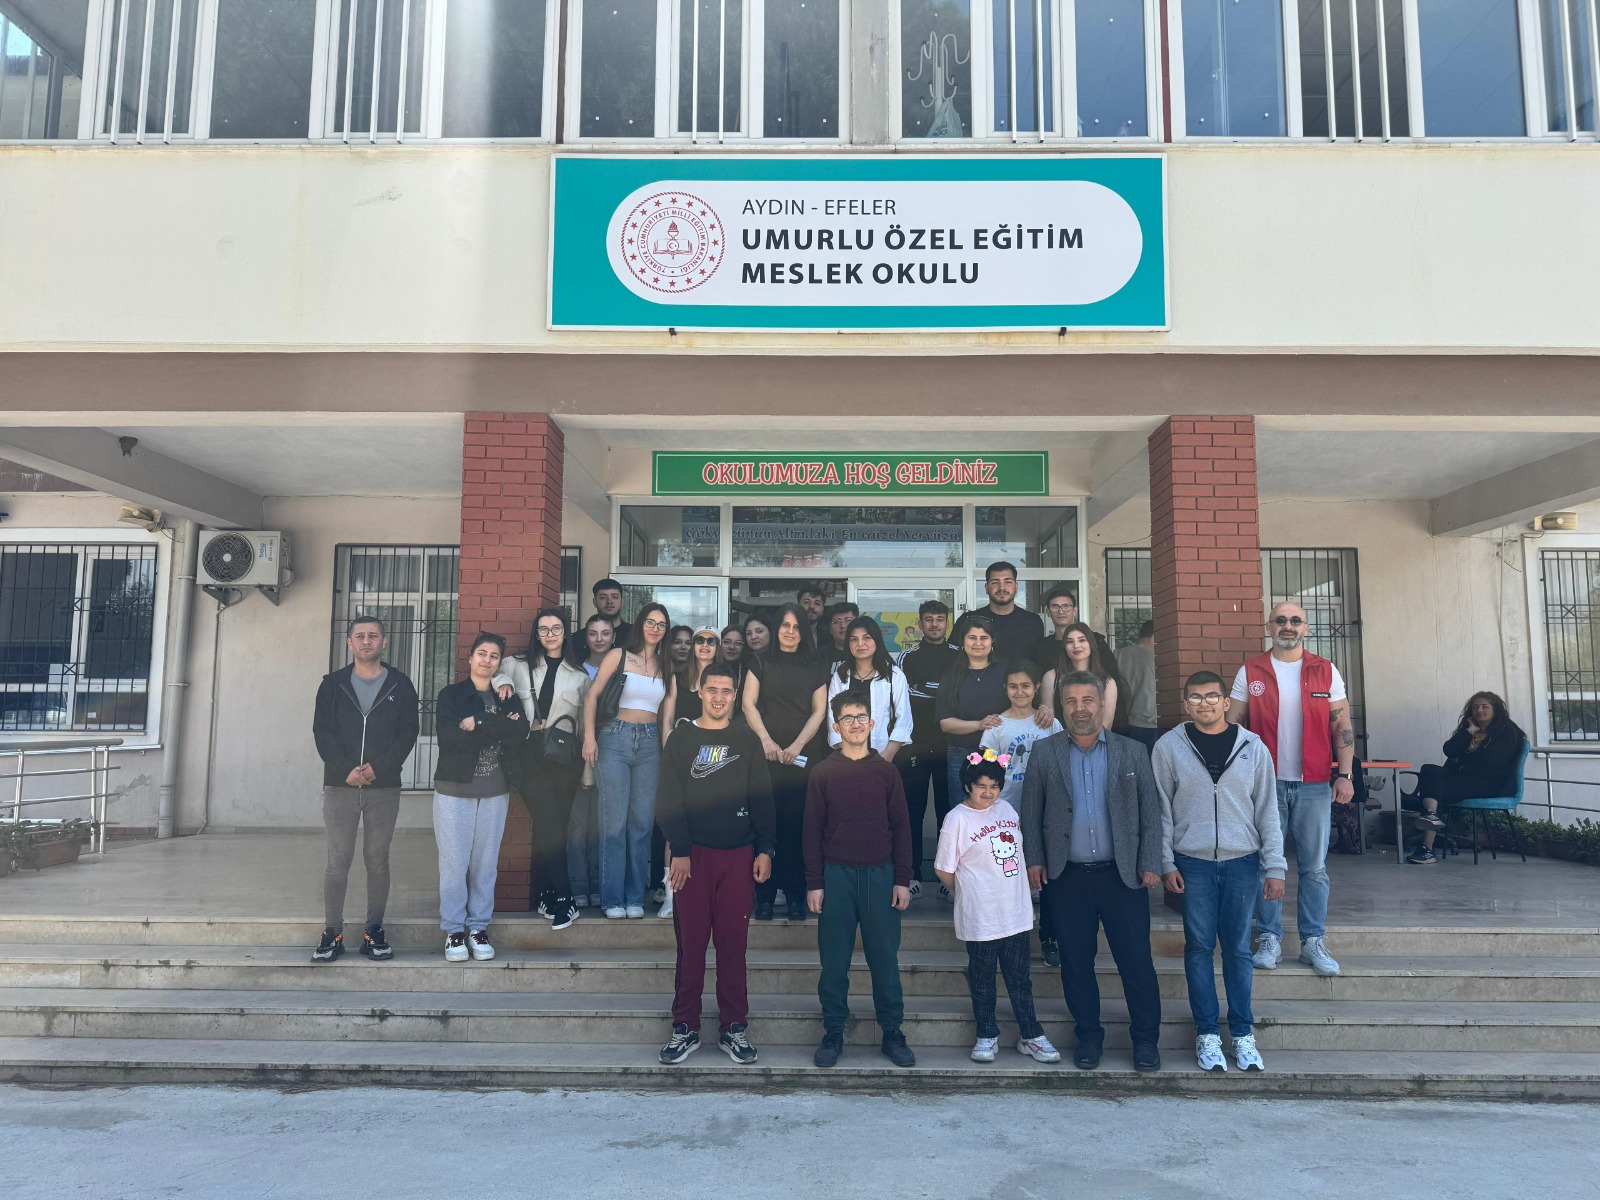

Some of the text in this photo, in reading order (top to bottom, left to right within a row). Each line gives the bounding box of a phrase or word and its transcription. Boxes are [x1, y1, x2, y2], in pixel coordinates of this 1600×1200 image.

[741, 199, 805, 216] AYDIN
[824, 199, 896, 216] EFELER
[742, 223, 1083, 251] UMURLU ÖZEL EĞİTİM
[741, 262, 979, 285] MESLEK OKULU
[702, 458, 998, 489] OKULUMUZA HOŞ GELDİNİZ
[685, 525, 960, 544] Gökyzünün Altındaki En Güzel Yeryüzü
[697, 745, 729, 763] NIKE
[970, 826, 996, 842] Hello
